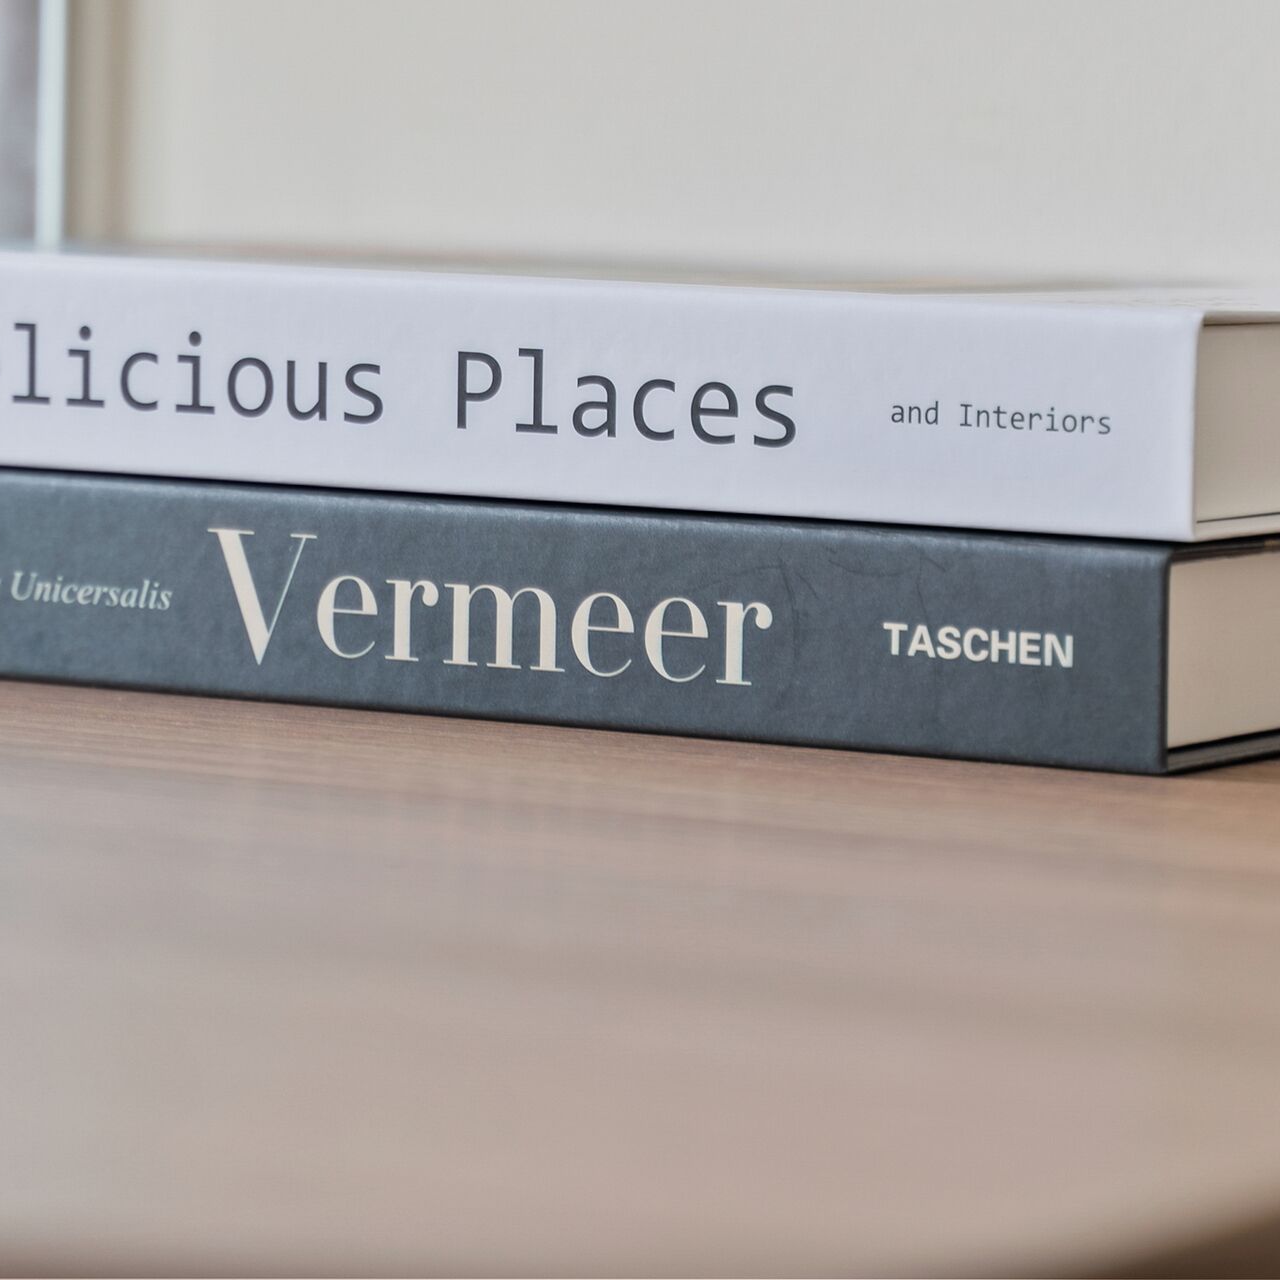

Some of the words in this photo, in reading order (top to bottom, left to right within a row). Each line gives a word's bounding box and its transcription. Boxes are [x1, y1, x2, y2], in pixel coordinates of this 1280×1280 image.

[456, 347, 798, 448] Places
[890, 400, 940, 426] and
[958, 402, 1112, 436] Interiors
[207, 527, 774, 687] Vermeer
[882, 621, 1075, 669] TASCHEN
